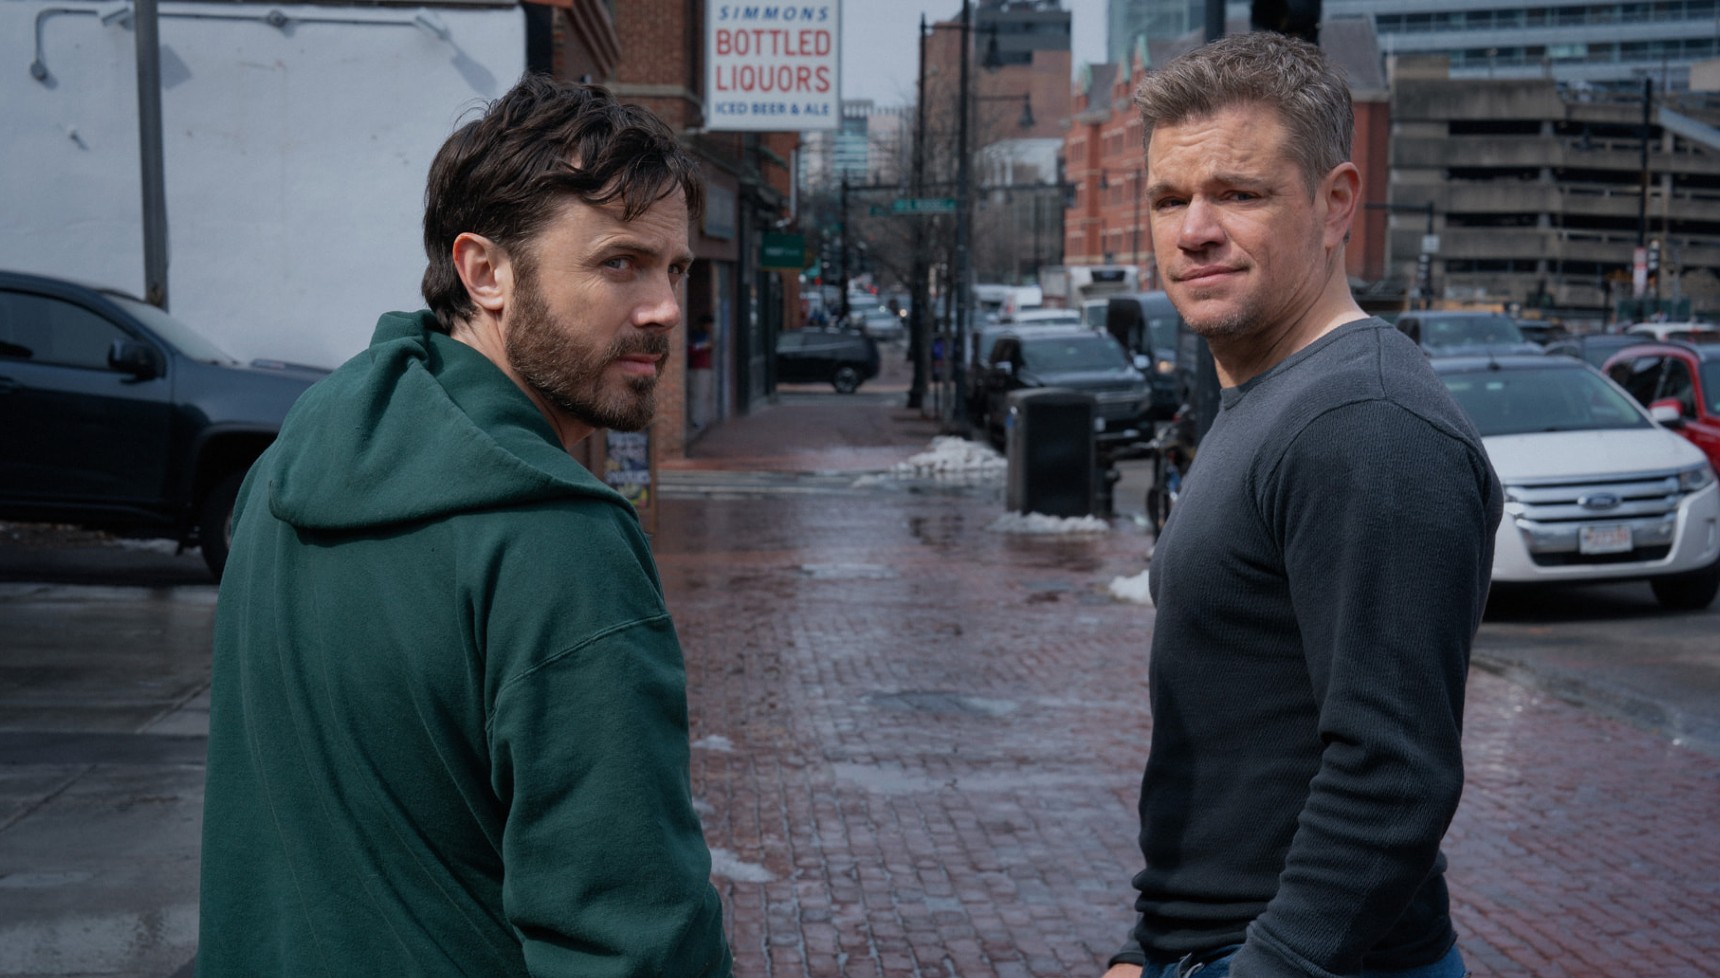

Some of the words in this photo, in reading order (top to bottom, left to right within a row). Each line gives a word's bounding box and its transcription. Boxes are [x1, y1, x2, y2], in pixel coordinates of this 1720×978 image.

[719, 6, 829, 21] SIMMONS
[716, 28, 831, 56] BOTTLED
[716, 65, 830, 93] LIQUORS
[715, 103, 748, 116] ICED
[752, 103, 786, 116] BEER
[791, 103, 800, 116] &
[804, 103, 829, 116] ALE
